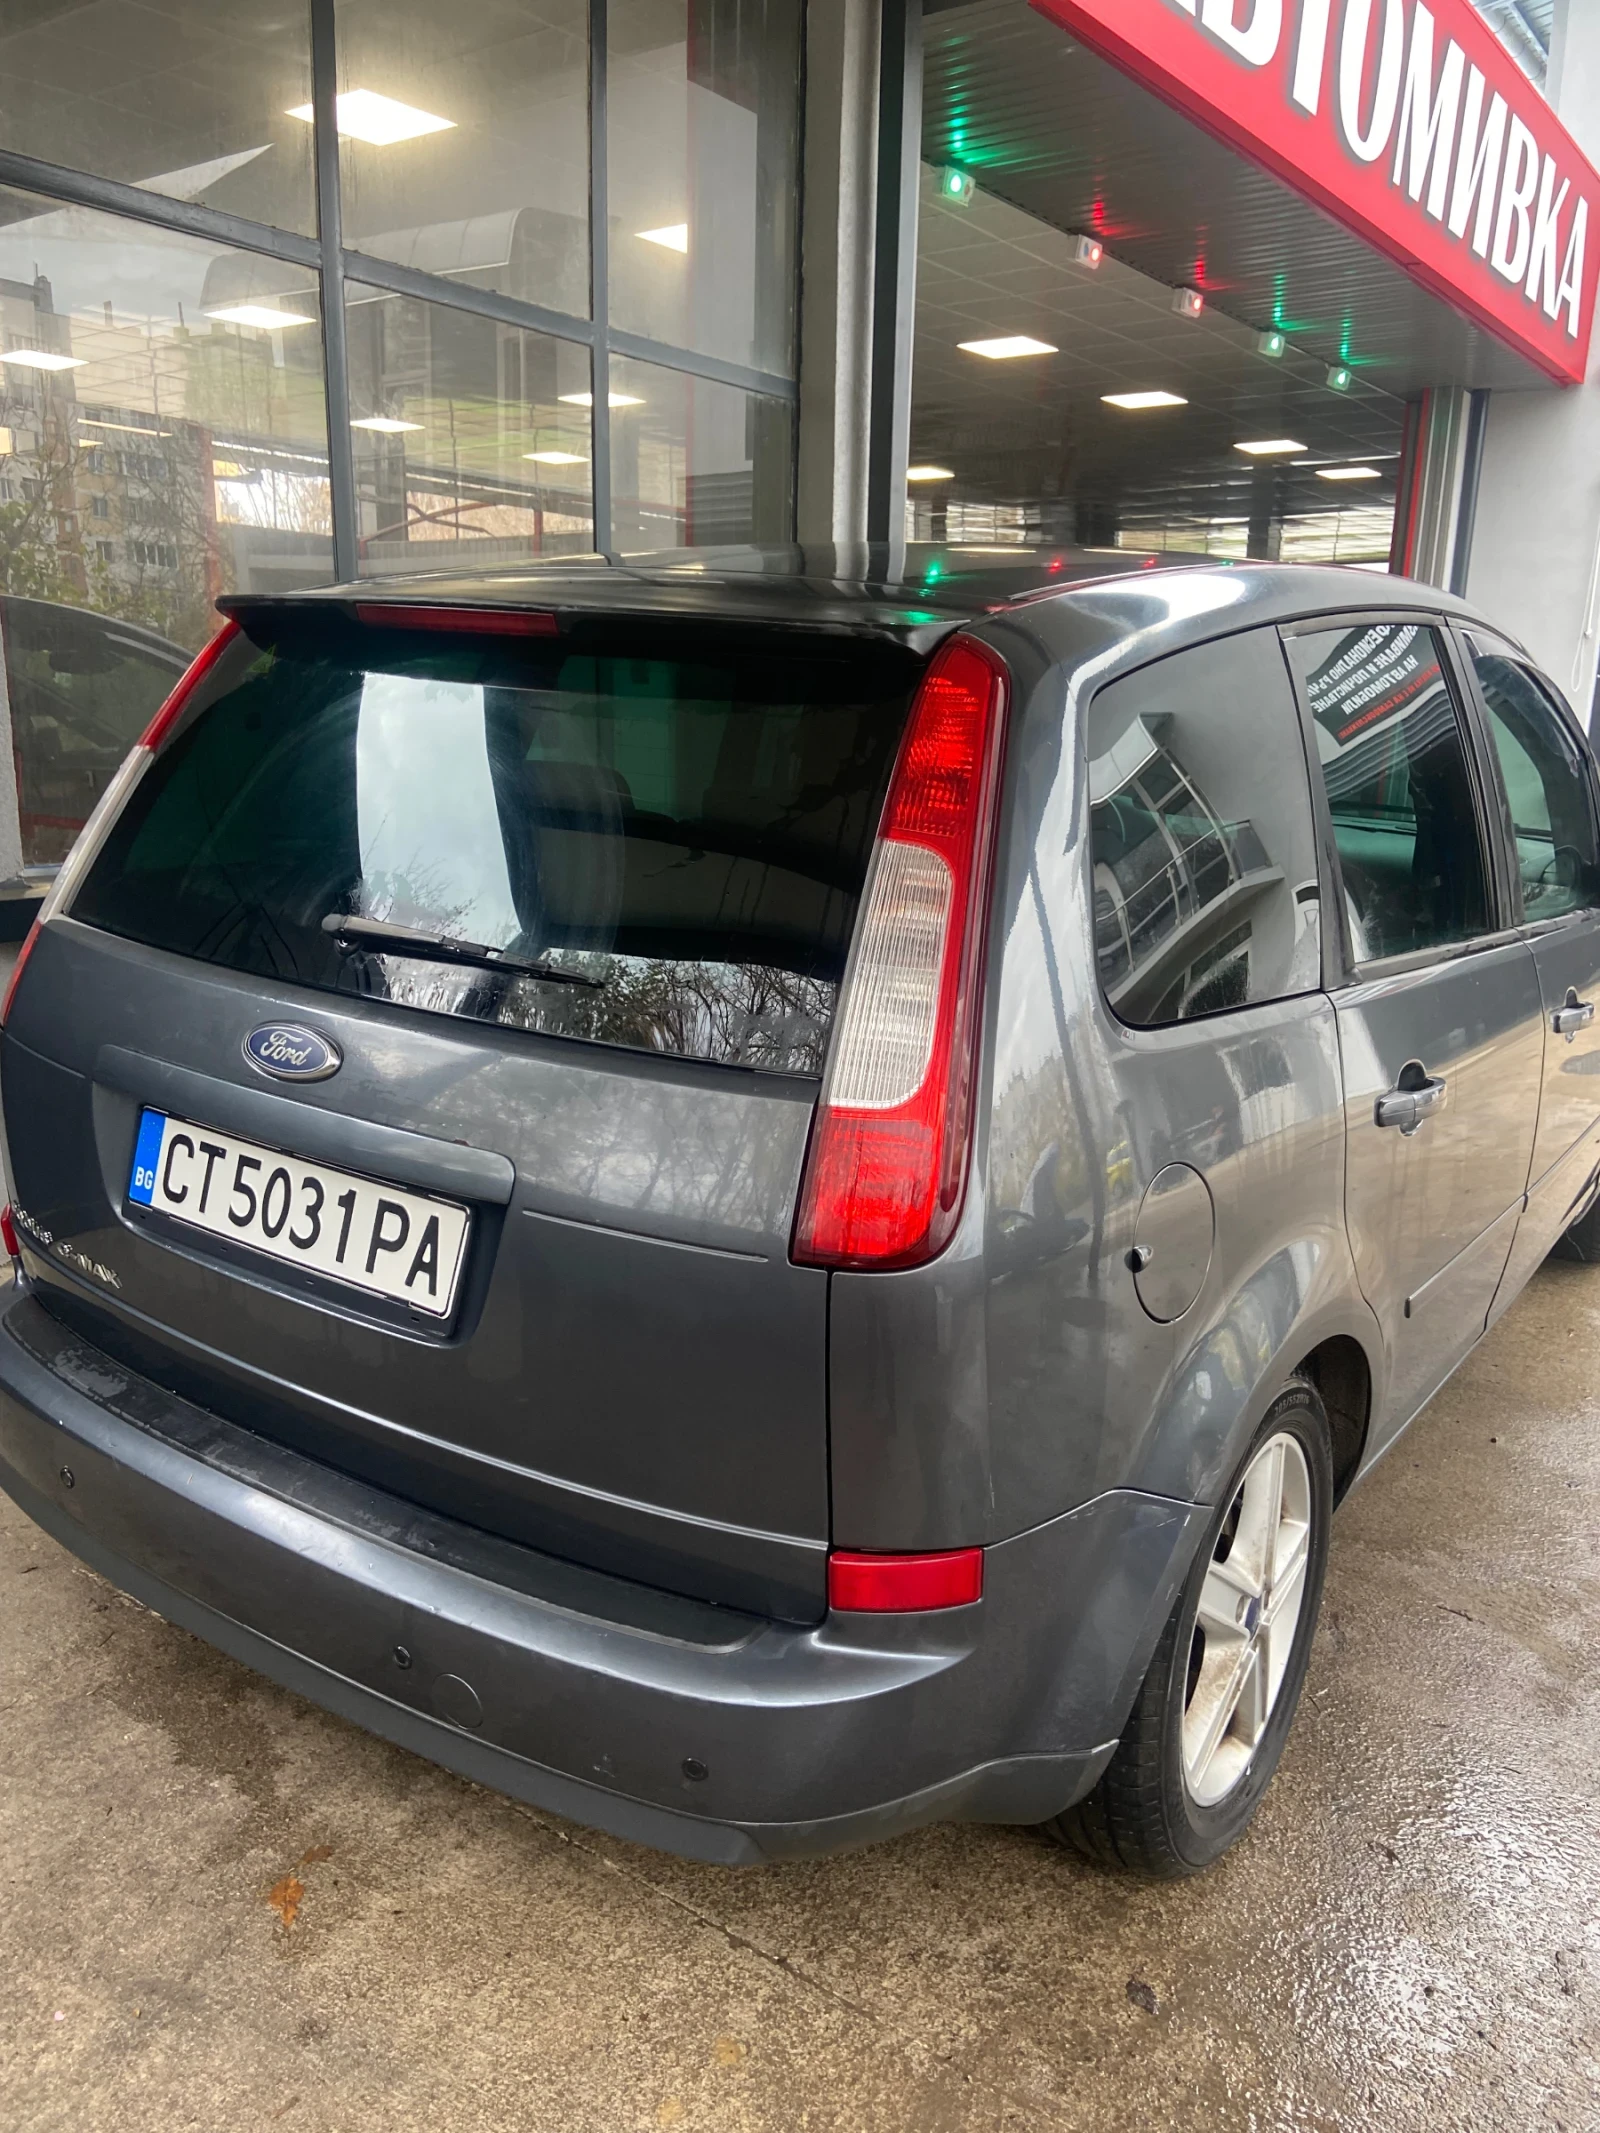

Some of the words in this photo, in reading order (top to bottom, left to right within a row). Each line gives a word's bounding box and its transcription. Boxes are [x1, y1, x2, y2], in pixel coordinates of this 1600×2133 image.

[1174, 0, 1589, 339] ОМИВКА
[260, 1030, 312, 1066] Ford
[134, 1166, 154, 1191] BG
